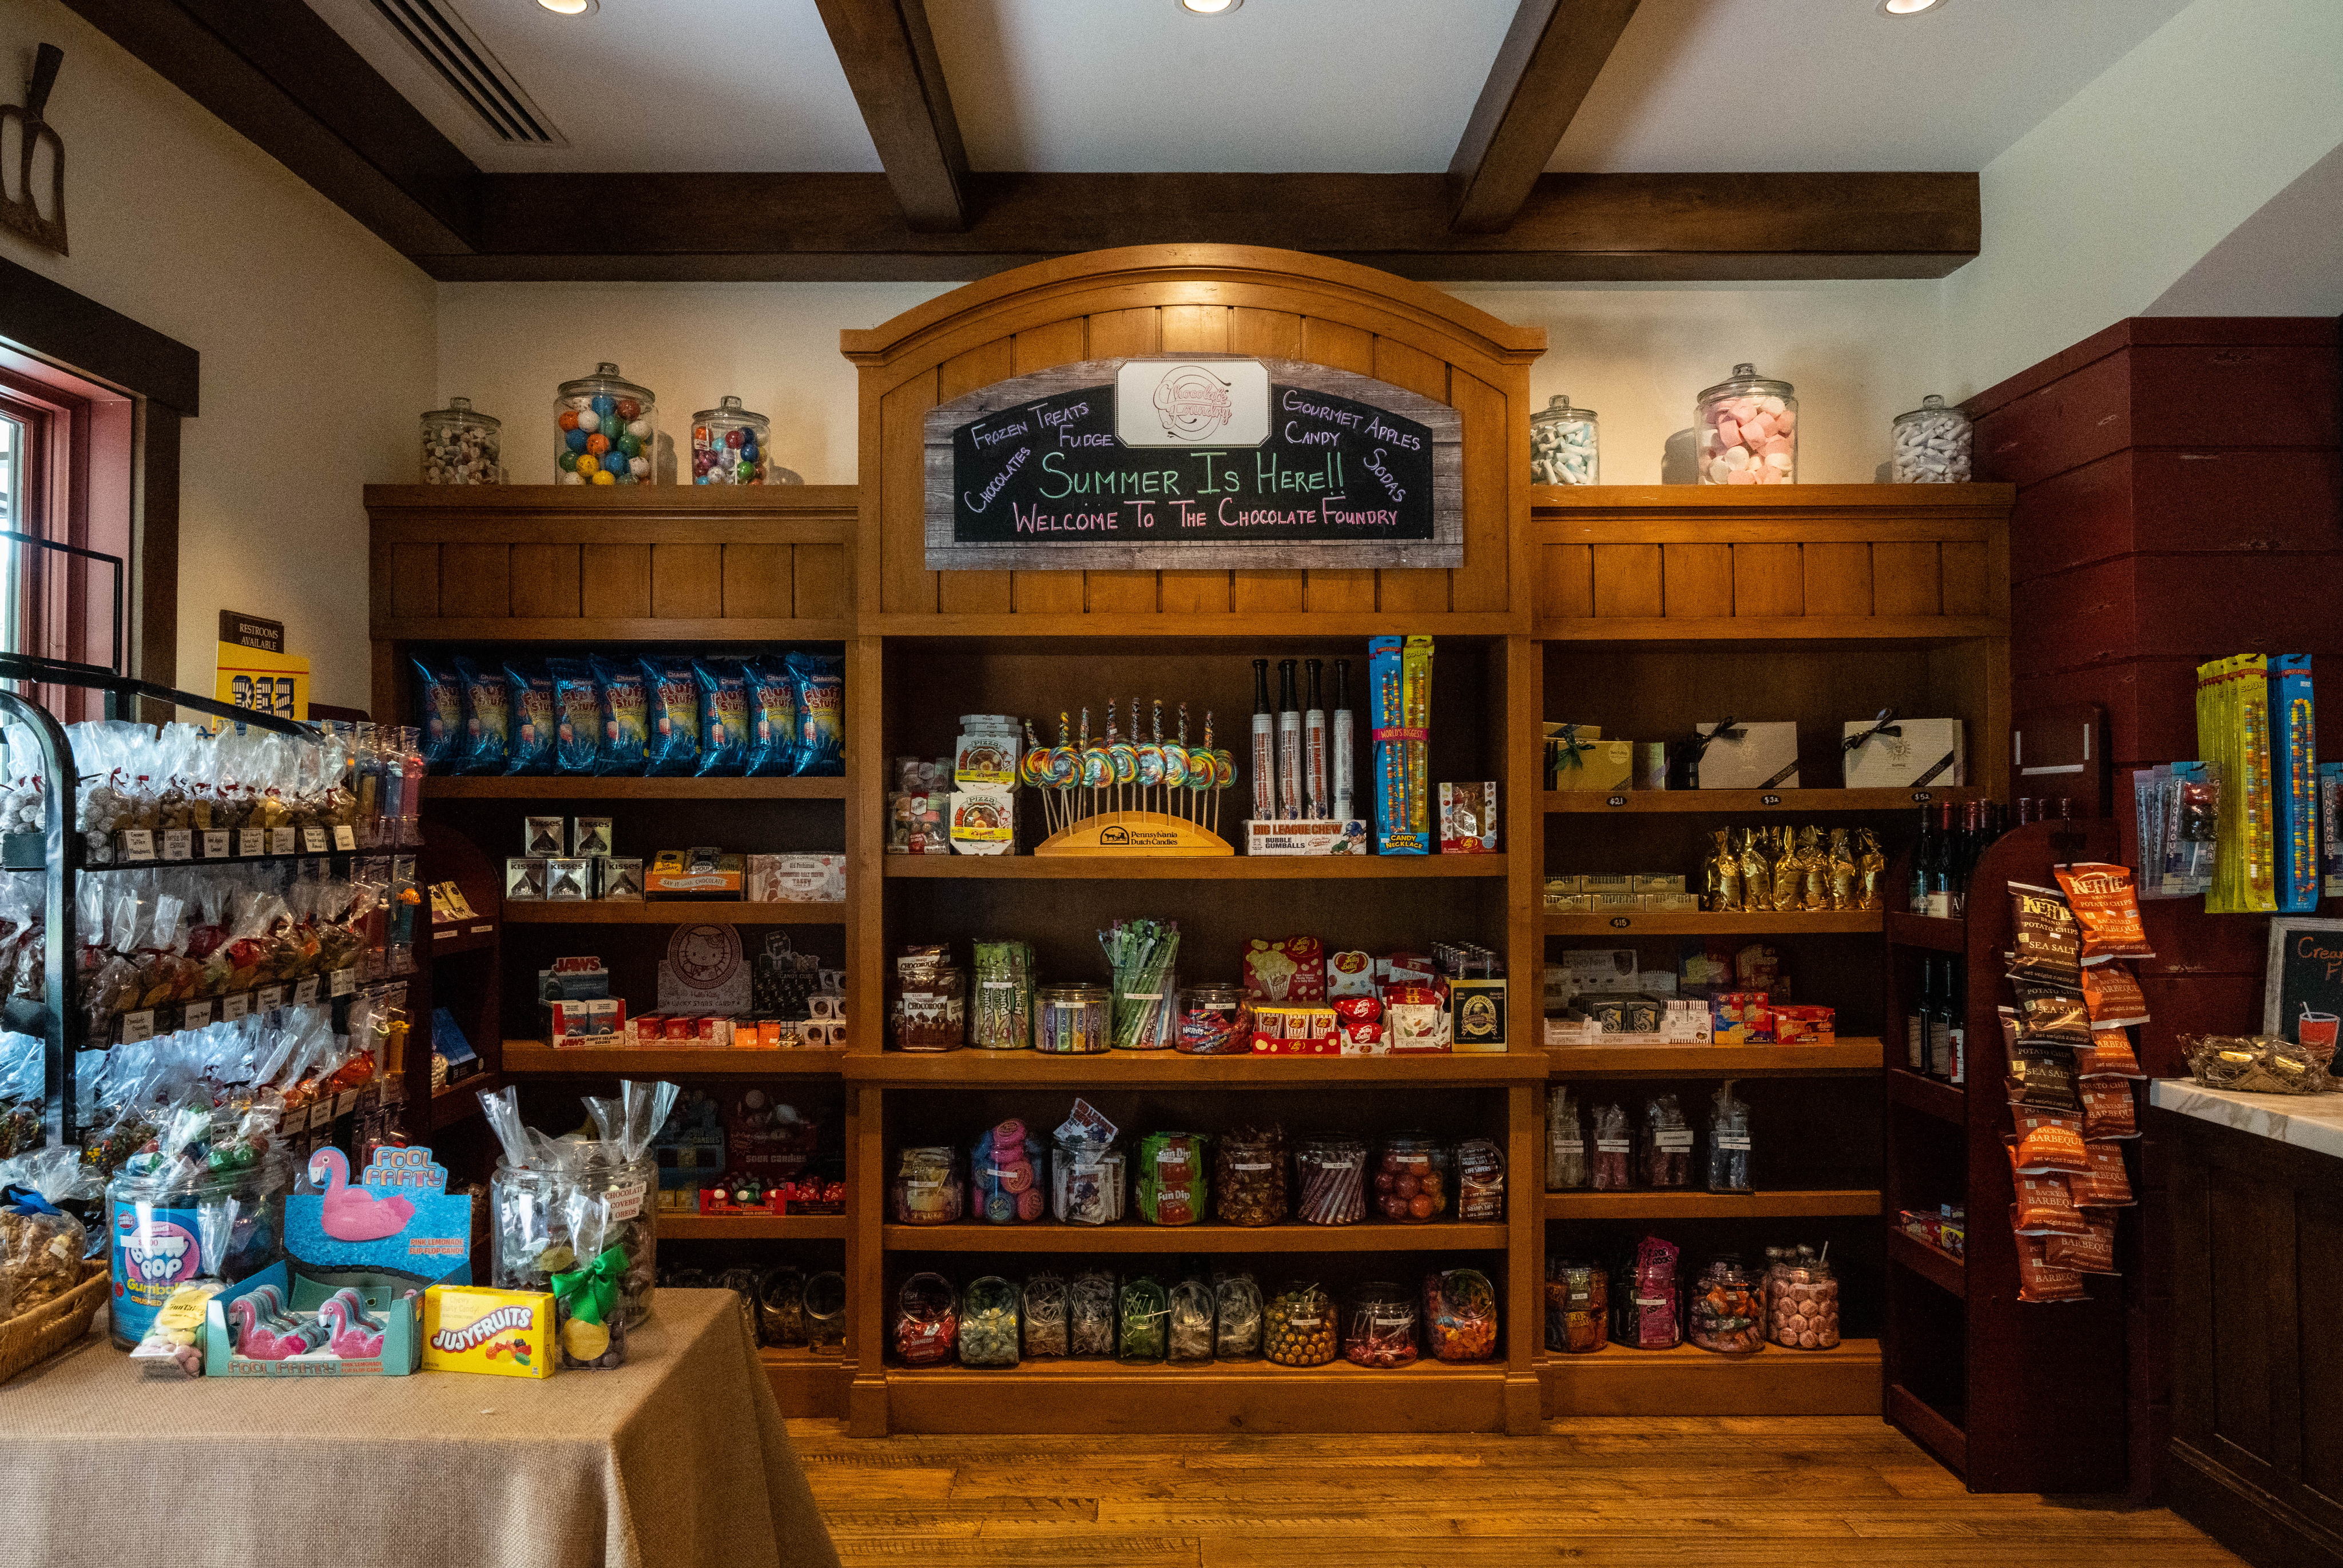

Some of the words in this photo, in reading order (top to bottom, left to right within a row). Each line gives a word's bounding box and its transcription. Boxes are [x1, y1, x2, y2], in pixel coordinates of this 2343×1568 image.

[1153, 380, 1232, 410] Chocolate
[1162, 403, 1232, 429] Foundry
[1283, 390, 1363, 429] GOURMET
[1364, 416, 1420, 451] APPLES
[971, 423, 1028, 450] FROZEN
[1027, 402, 1089, 428] TREATS
[1061, 425, 1114, 447] FUDGE
[1285, 421, 1340, 447] CANDY
[964, 447, 1030, 513] CHOCOLATES
[1039, 452, 1180, 498] SUMMER
[1257, 452, 1344, 496] HERE!!
[1363, 448, 1406, 502] SODAS
[1012, 502, 1118, 533] WELCOME
[1123, 500, 1154, 527] TO
[1169, 500, 1208, 527] THE
[1218, 498, 1317, 527] CHOCOLATE
[1322, 495, 1397, 525] FOUNDRY
[240, 623, 278, 639] RESTROOMS
[241, 636, 276, 650] AVAILABLE
[1405, 650, 1427, 659] SOUR
[2241, 682, 2265, 692] SOUR
[615, 698, 645, 709] Stuff
[667, 695, 695, 706] Stuff
[1403, 730, 1423, 738] BIGGEST
[1764, 796, 1780, 804] $32
[2169, 779, 2181, 859] GINORMOUS
[2324, 781, 2334, 860] GINORMOUS
[1131, 831, 1178, 839] Pennsylvania
[1253, 825, 1270, 835] BIG
[1273, 825, 1311, 835] LEAGUE
[1312, 824, 1343, 835] CHEW
[1308, 839, 1331, 847] Original
[1385, 841, 1423, 850] NECKLACE
[695, 877, 727, 885] CHOCOLATE
[2068, 875, 2128, 894] KETTLE
[1614, 918, 1627, 926] $15
[2040, 917, 2061, 926] BRAND
[2024, 921, 2054, 932] POTATO
[2055, 927, 2079, 935] CHIPS
[2094, 924, 2142, 933] BARBEQUE
[1296, 937, 1311, 946] Jelly
[1292, 944, 1309, 954] Belly
[2029, 941, 2050, 950] SEA
[2051, 944, 2077, 954] SALT
[555, 957, 601, 972] JAWS
[1345, 956, 1359, 964] Jelly
[1340, 962, 1357, 972] Belly
[2096, 985, 2139, 994] BARBEQUE
[1013, 981, 1023, 1015] PUNCH
[1353, 1007, 1369, 1015] Belly
[1401, 1006, 1412, 1014] Harry
[1413, 1005, 1426, 1013] Potter
[2038, 1005, 2058, 1014] SEA
[2060, 1006, 2085, 1015] SALT
[1182, 1026, 1204, 1035] Nerds
[1359, 1026, 1373, 1034] Jelly
[559, 1038, 585, 1046] JAWS
[1355, 1032, 1371, 1041] Belly
[2018, 1047, 2049, 1055] POTATO
[2026, 1068, 2046, 1076] SEA
[2047, 1069, 2071, 1079] SALT
[2037, 1128, 2076, 1136] BACKYARD
[2029, 1134, 2083, 1146] BARBEQUE
[1158, 1147, 1173, 1157] Fun
[1174, 1147, 1192, 1159] Dip
[376, 1149, 440, 1169] POOL
[1474, 1166, 1491, 1174] SAVERS
[365, 1168, 445, 1188] PARTY
[605, 1186, 644, 1200] CHOCOLATE
[1157, 1192, 1174, 1201] Fun
[1174, 1191, 1191, 1203] Dip
[610, 1197, 640, 1210] COVERED
[615, 1208, 637, 1219] OREOS
[1654, 1248, 1668, 1257] POP
[1653, 1255, 1673, 1265] ROCKS
[141, 1258, 183, 1280] POP
[131, 1295, 162, 1307] CRUSHED
[450, 1295, 470, 1305] Chewy
[1570, 1312, 1587, 1322] RIP
[433, 1307, 533, 1351] JUJYFRUITS
[228, 1362, 267, 1374] POOL
[276, 1362, 336, 1374] PARTY
